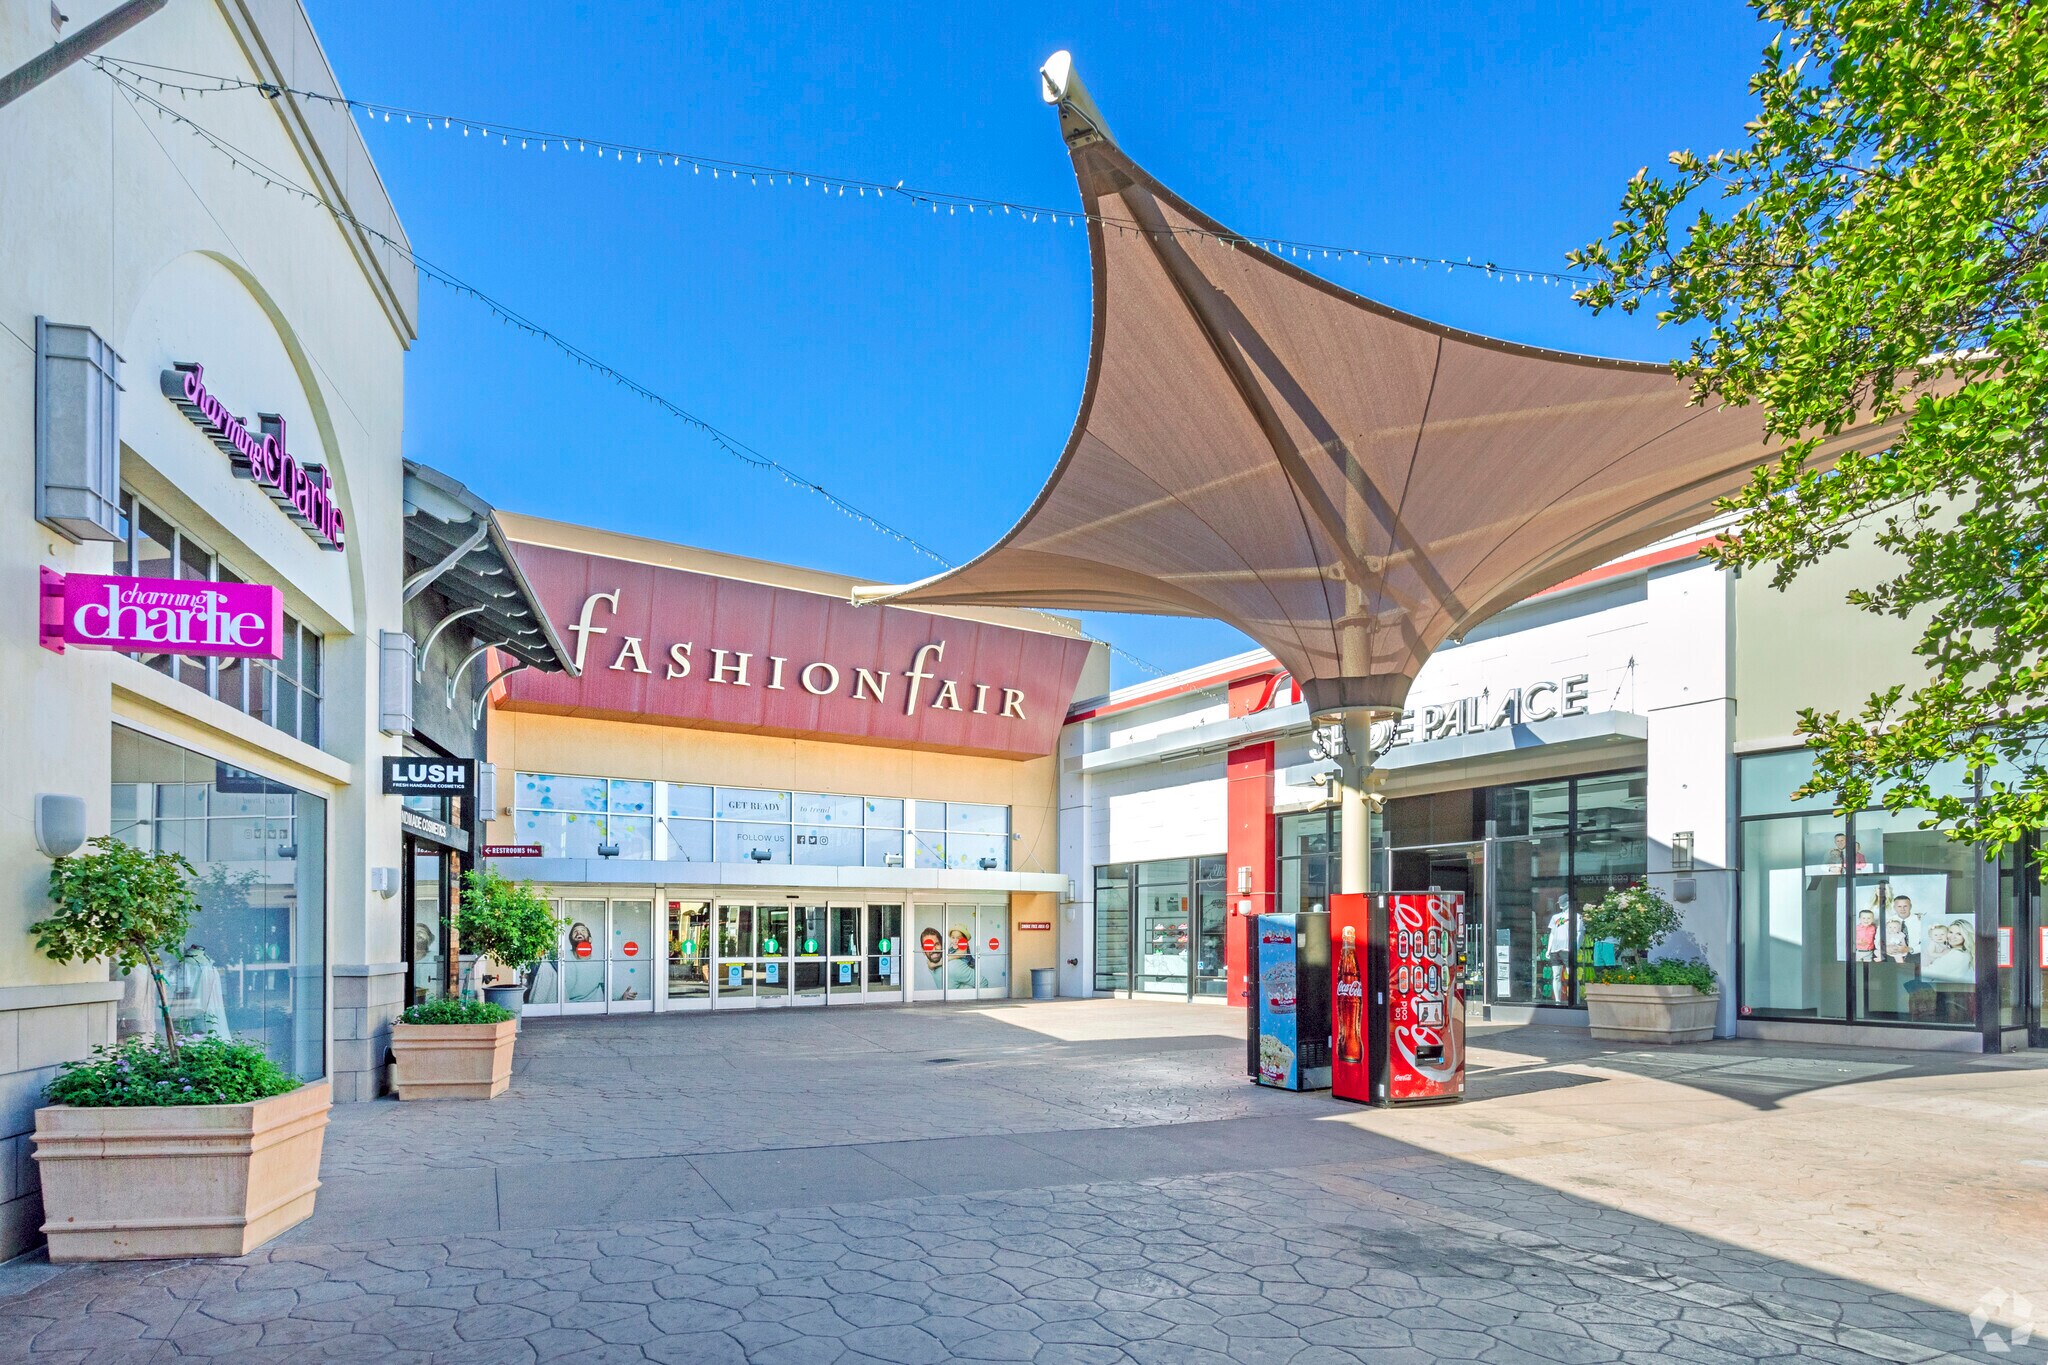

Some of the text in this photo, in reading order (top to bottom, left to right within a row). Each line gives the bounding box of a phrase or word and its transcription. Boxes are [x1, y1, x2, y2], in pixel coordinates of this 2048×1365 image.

[183, 362, 345, 552] charming charlie
[120, 583, 207, 615] charming
[73, 583, 266, 647] charlie
[1421, 674, 1590, 742] PALACE
[392, 763, 465, 783] LUSH
[728, 801, 748, 810] GET
[750, 802, 781, 811] READY
[810, 806, 831, 814] trend
[401, 810, 447, 838] NDMADE COSMETICS
[737, 833, 785, 843] FOLLOW US
[1400, 1000, 1408, 1020] cold
